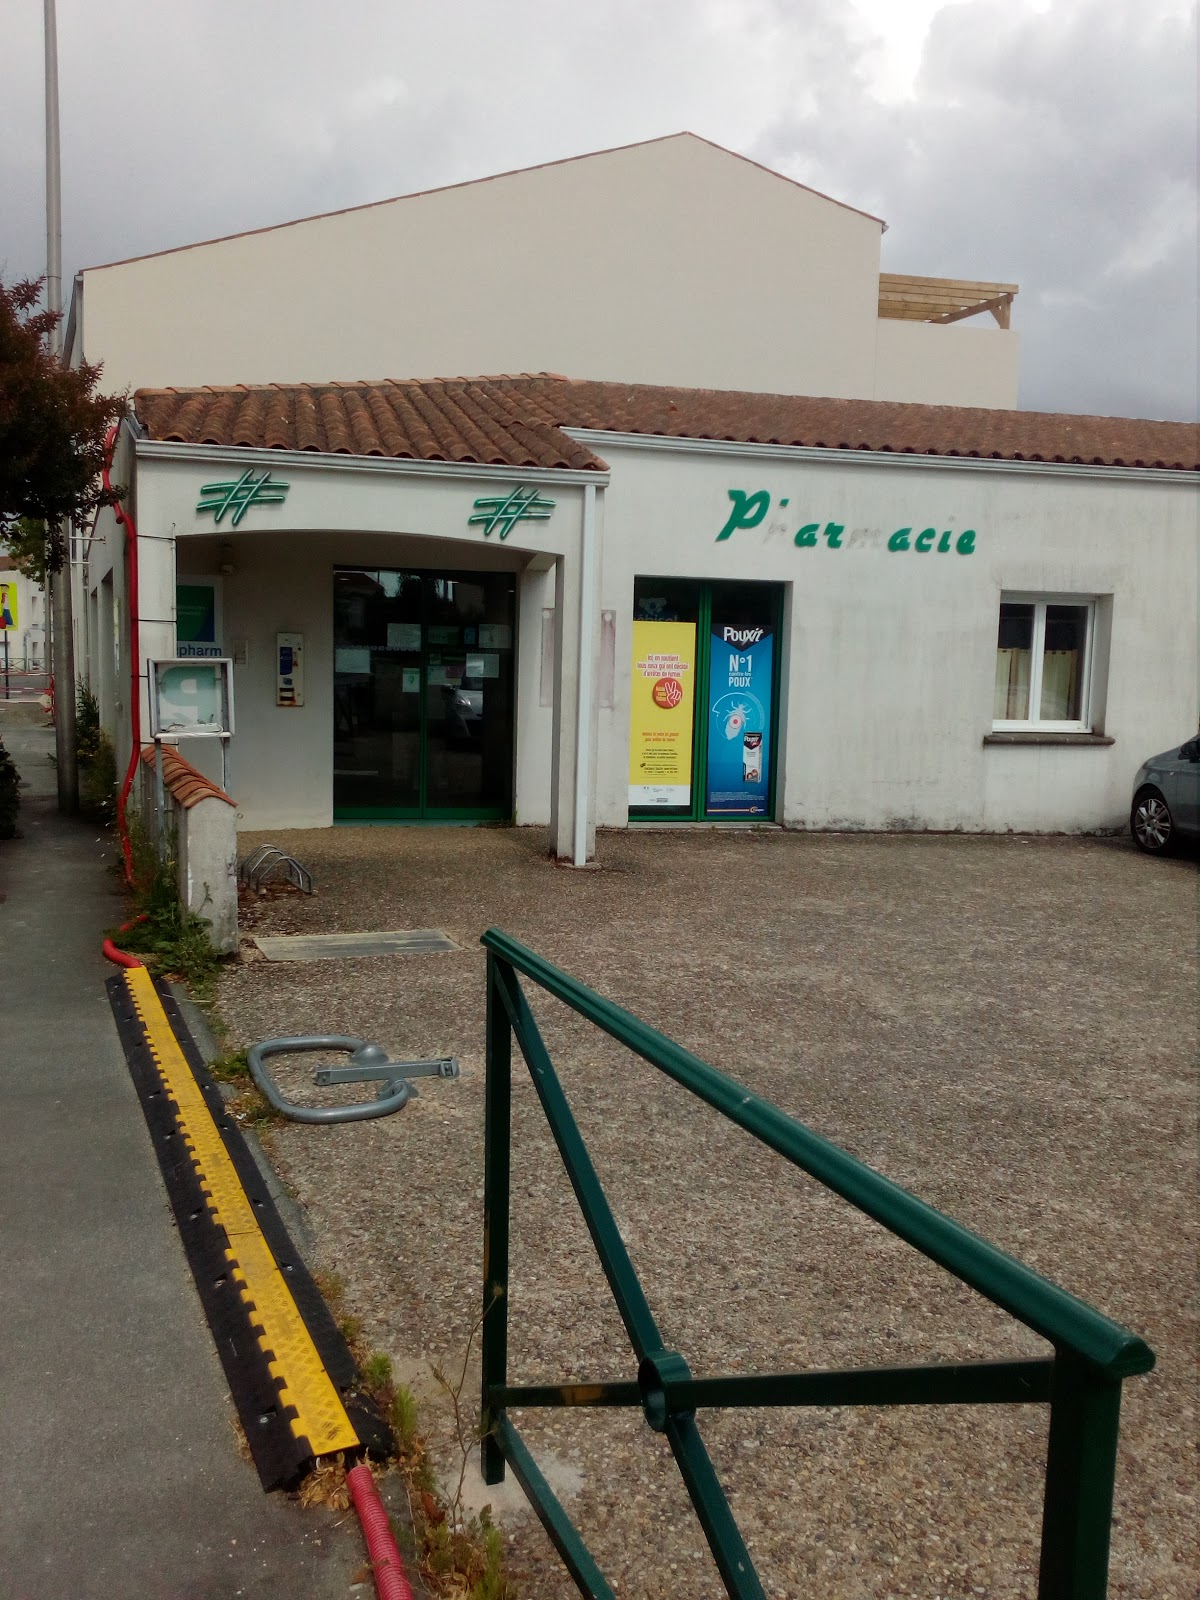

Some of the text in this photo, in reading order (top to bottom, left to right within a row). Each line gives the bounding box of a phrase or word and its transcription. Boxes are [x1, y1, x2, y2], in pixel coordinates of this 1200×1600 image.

[723, 626, 764, 646] Pouxit
[177, 644, 222, 658] pharm
[729, 654, 752, 672] N°1
[729, 677, 751, 687] POUX
